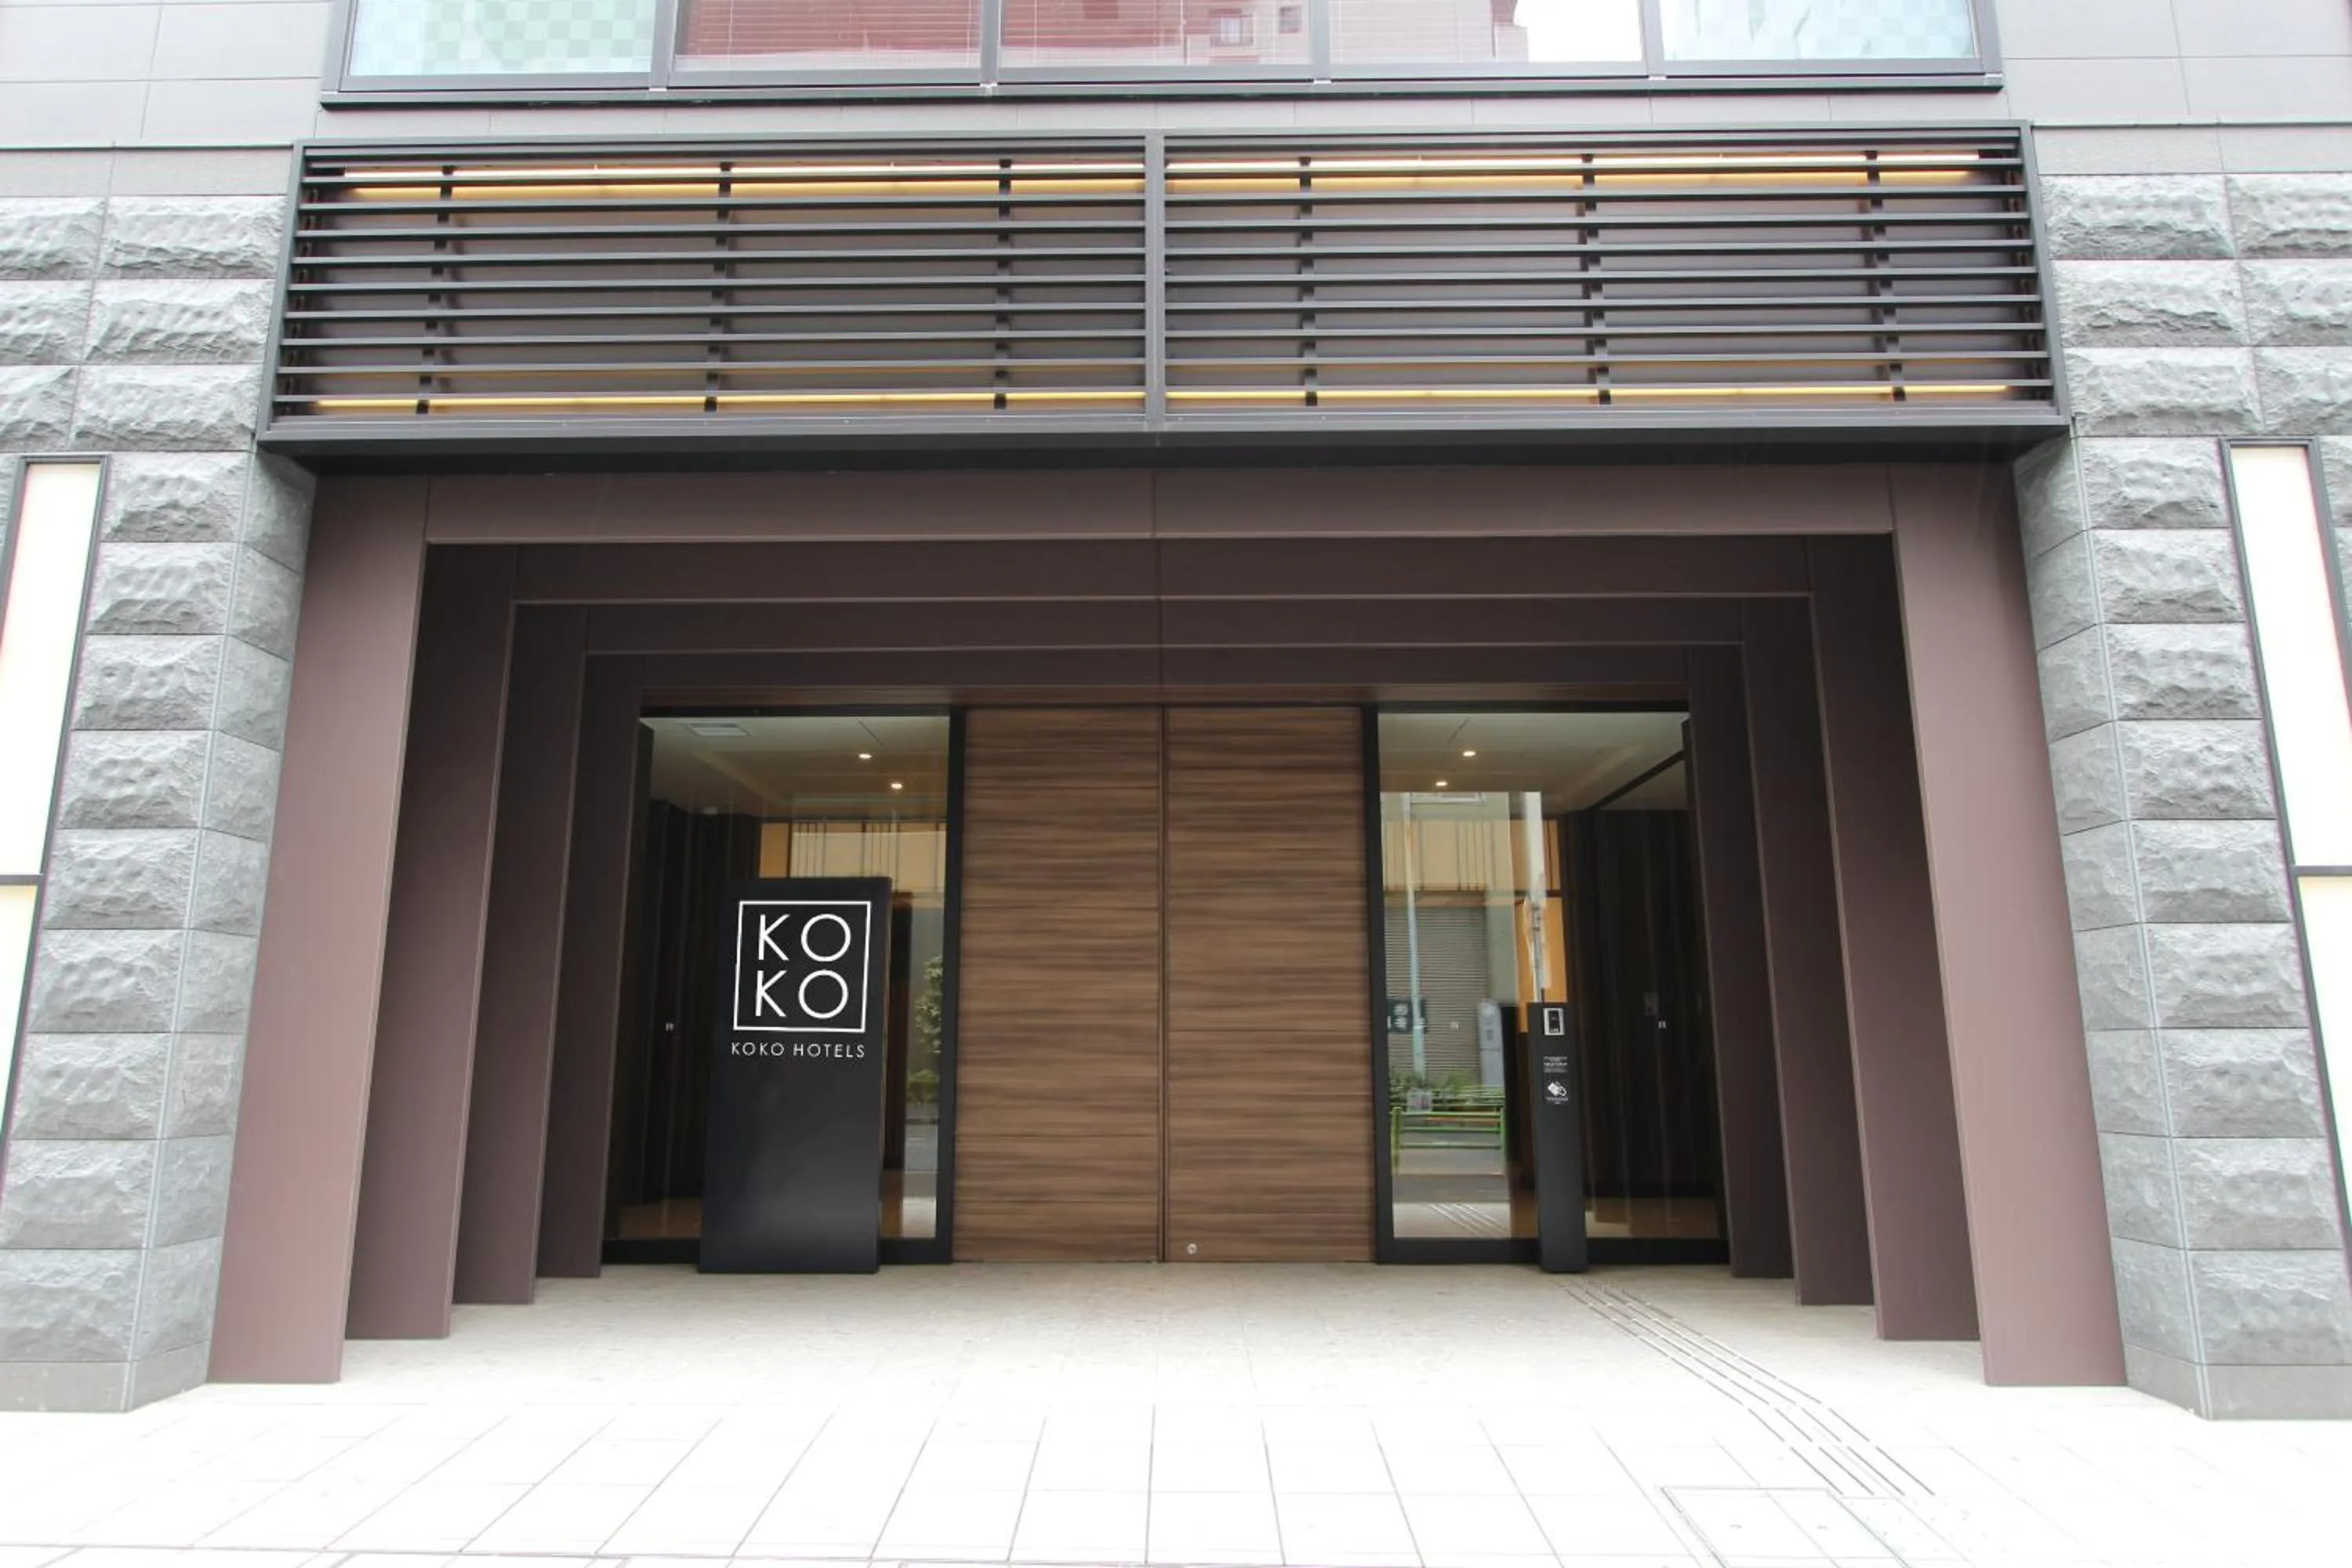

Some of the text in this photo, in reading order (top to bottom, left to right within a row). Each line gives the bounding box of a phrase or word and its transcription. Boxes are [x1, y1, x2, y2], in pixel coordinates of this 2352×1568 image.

[757, 913, 851, 962] KO
[755, 969, 848, 1019] KO
[731, 1042, 865, 1058] KOKO HOTELS
